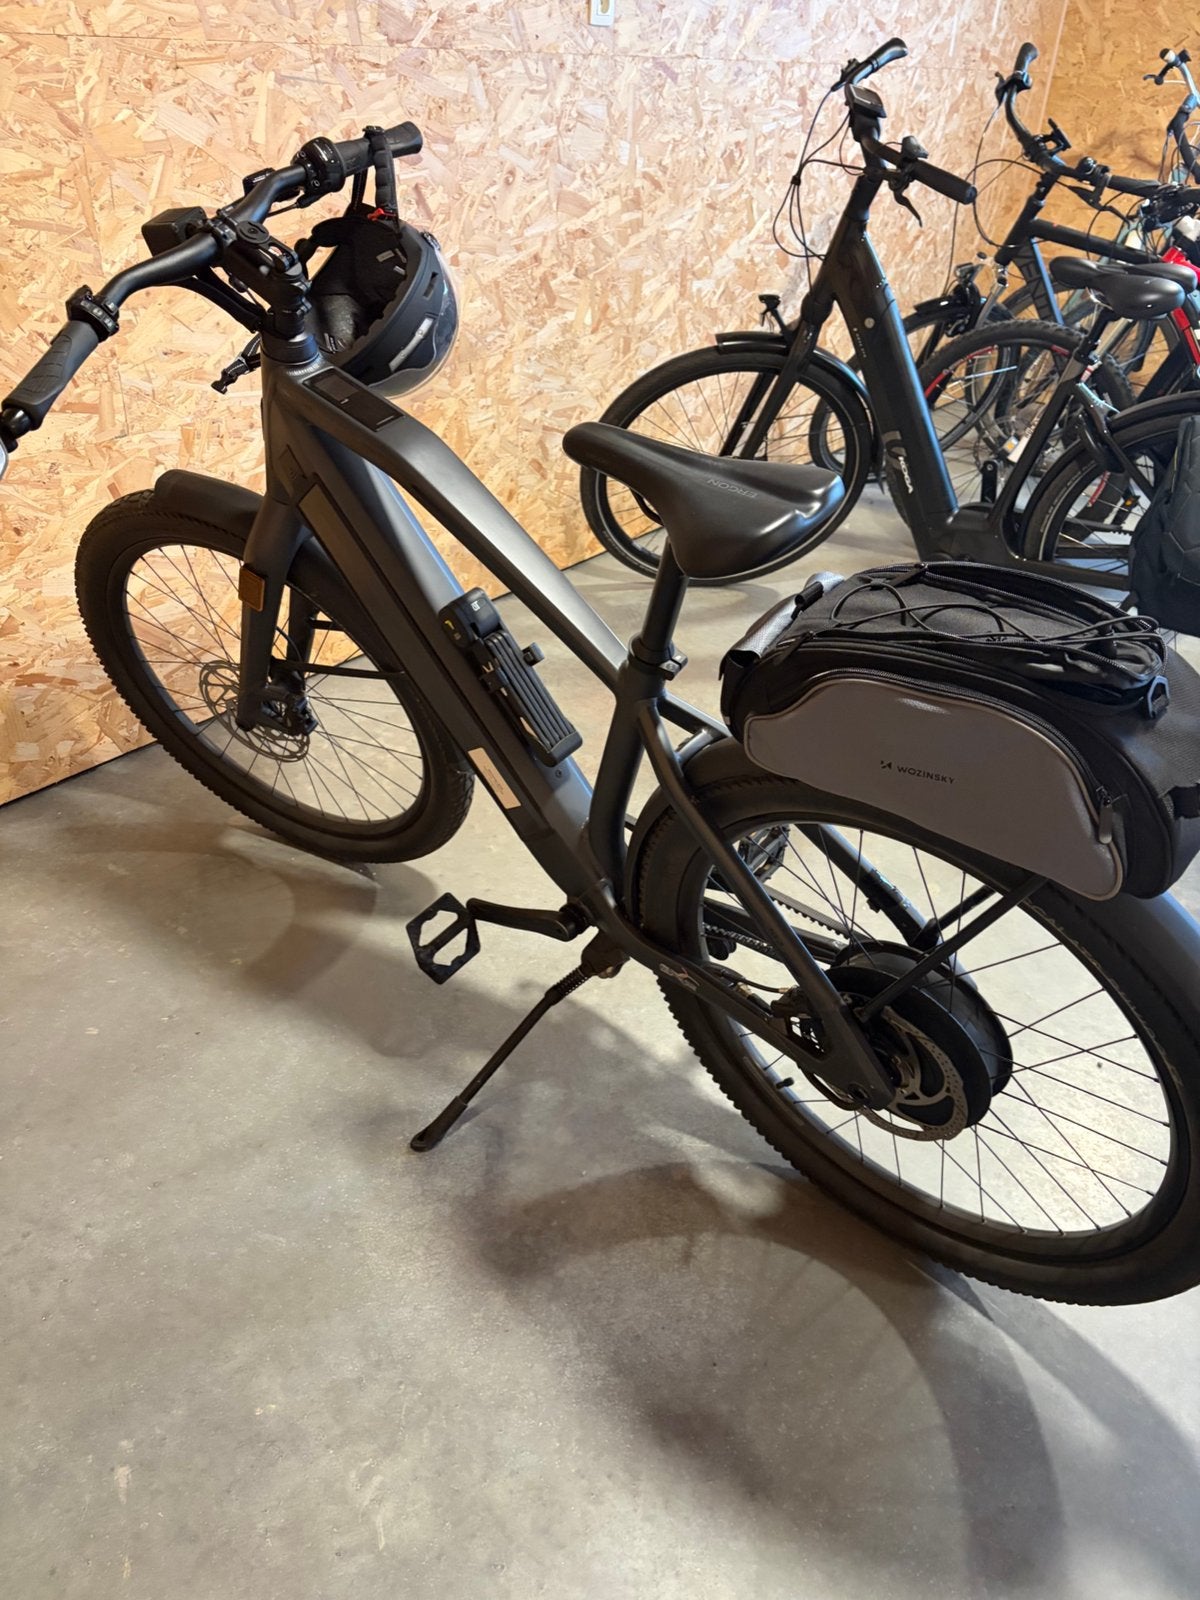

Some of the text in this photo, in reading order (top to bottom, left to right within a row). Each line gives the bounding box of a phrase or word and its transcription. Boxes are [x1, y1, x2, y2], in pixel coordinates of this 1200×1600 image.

[898, 456, 914, 494] KOGA
[706, 479, 758, 498] ERGON
[896, 765, 955, 784] WOZINSKY
